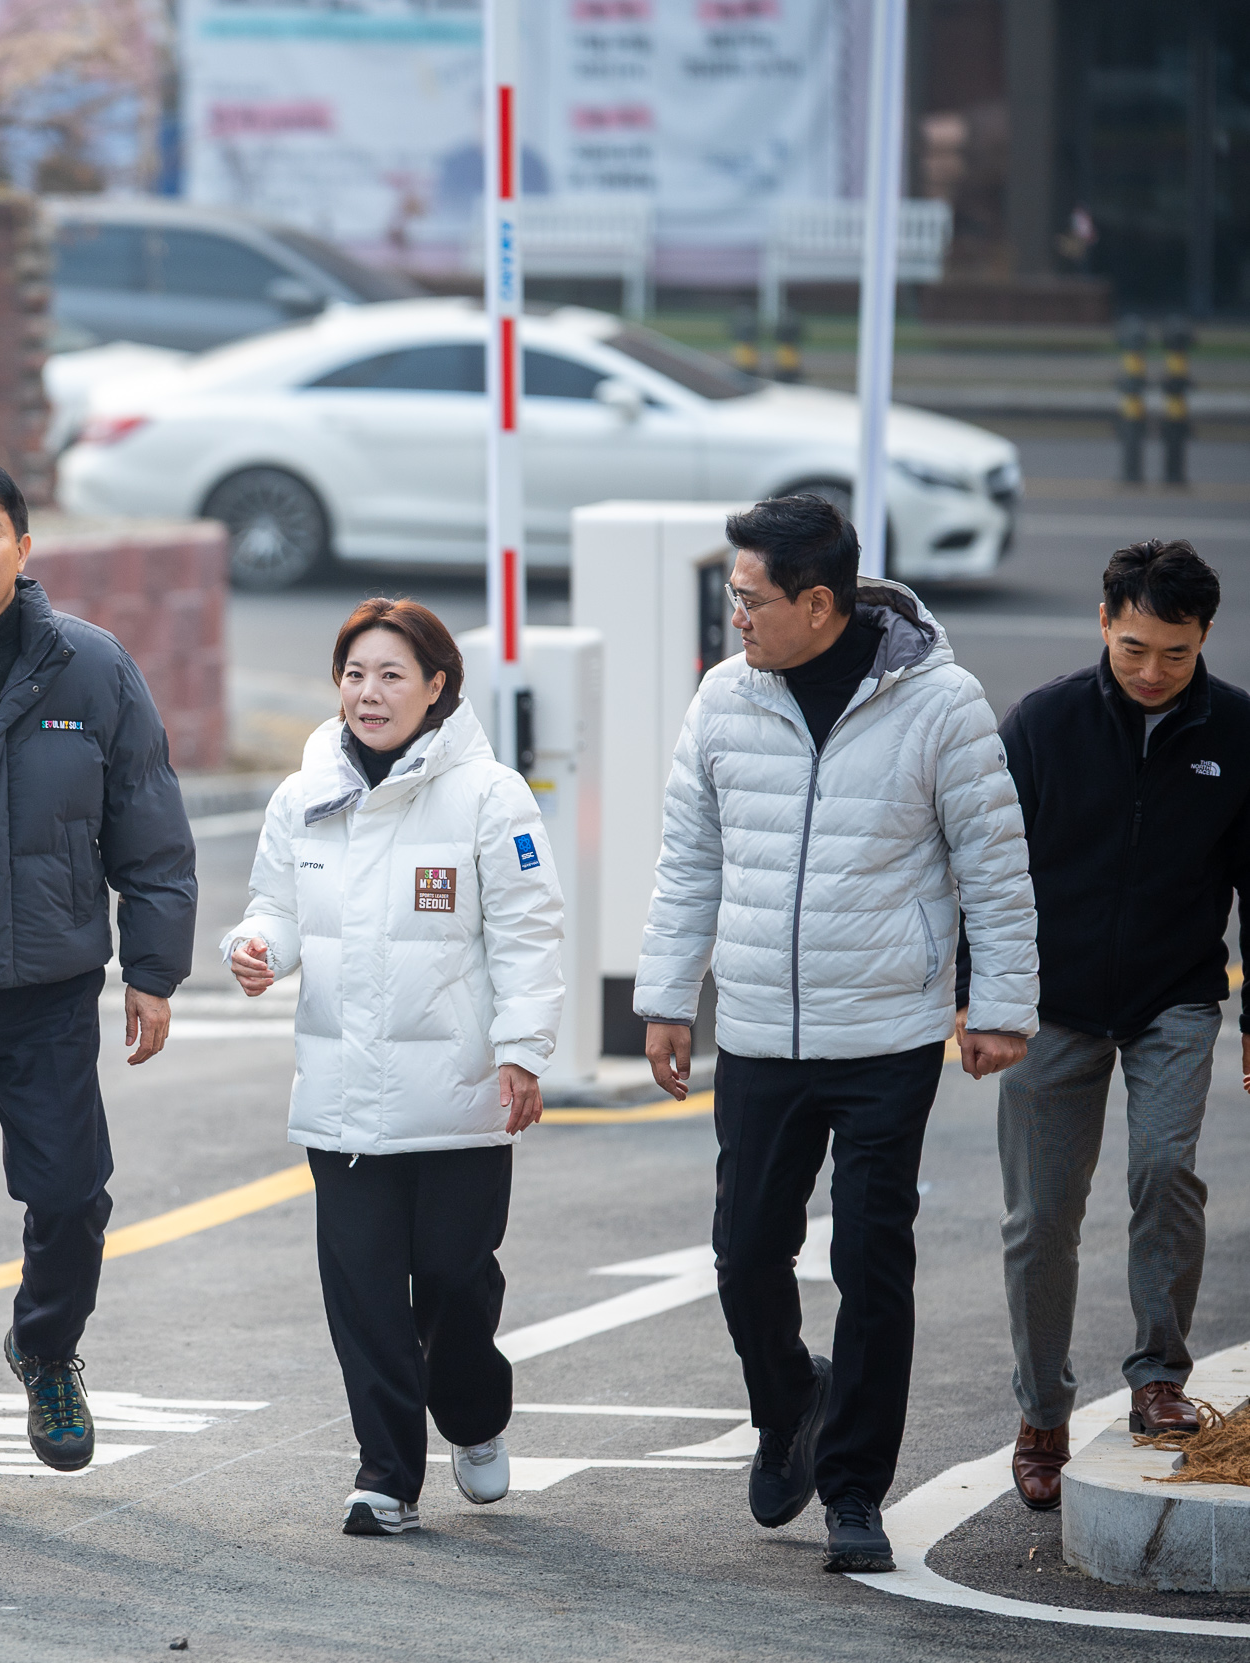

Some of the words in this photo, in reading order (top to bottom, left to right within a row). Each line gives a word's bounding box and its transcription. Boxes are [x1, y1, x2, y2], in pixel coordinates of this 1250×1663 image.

[1190, 763, 1212, 771] NORTH
[1195, 768, 1212, 776] FACE
[432, 879, 452, 890] SOUL
[418, 898, 452, 910] SEOUL
